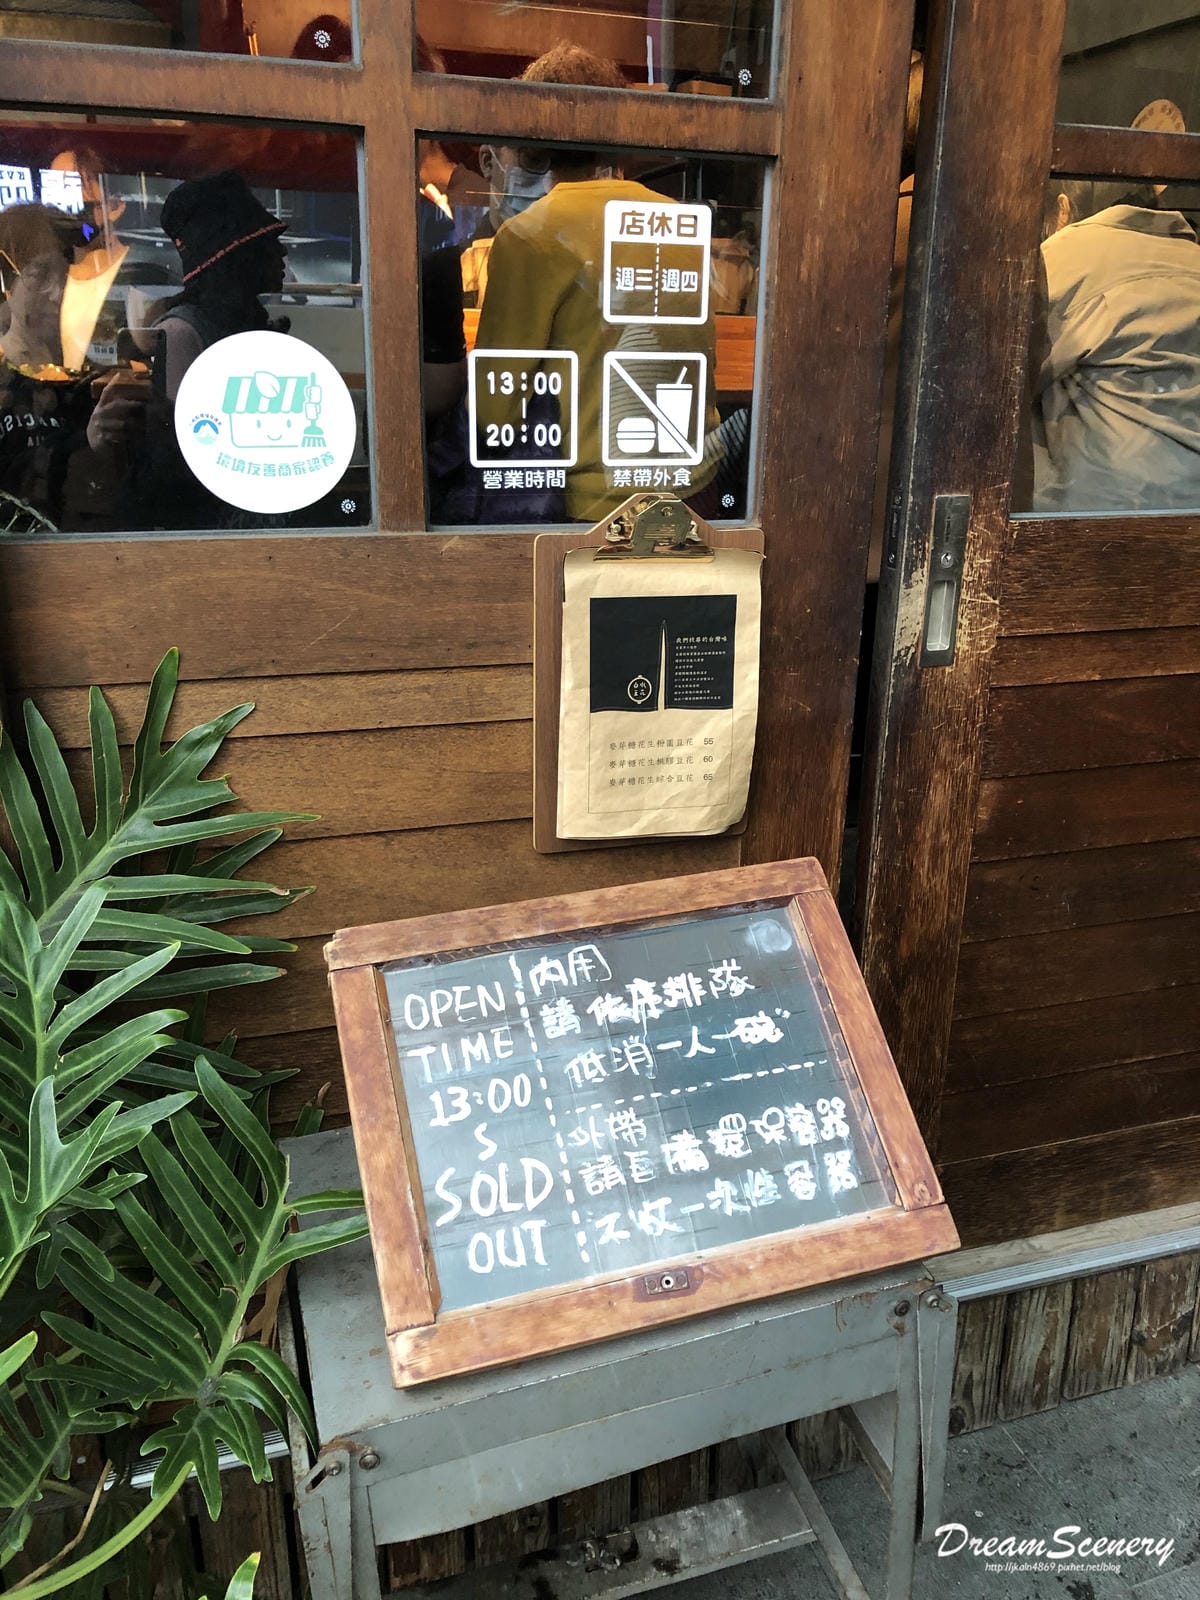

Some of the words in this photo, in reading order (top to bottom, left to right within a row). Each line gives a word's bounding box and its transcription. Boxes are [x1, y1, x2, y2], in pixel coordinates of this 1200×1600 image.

[619, 210, 698, 237] 店休日
[616, 267, 653, 291] 週三
[662, 269, 698, 292] 週四
[487, 371, 562, 395] 13:00
[486, 424, 562, 447] 20:00
[483, 470, 566, 489] 營業時間
[613, 468, 691, 487] 禁帶外食
[703, 755, 714, 763] 60
[703, 773, 713, 781] 65
[403, 981, 505, 1031] OPEN
[407, 1026, 514, 1084] TIME
[428, 1074, 532, 1127] 13:00
[567, 1106, 647, 1149] 外帶
[435, 1158, 554, 1227] SOLD
[467, 1220, 548, 1273] OUT
